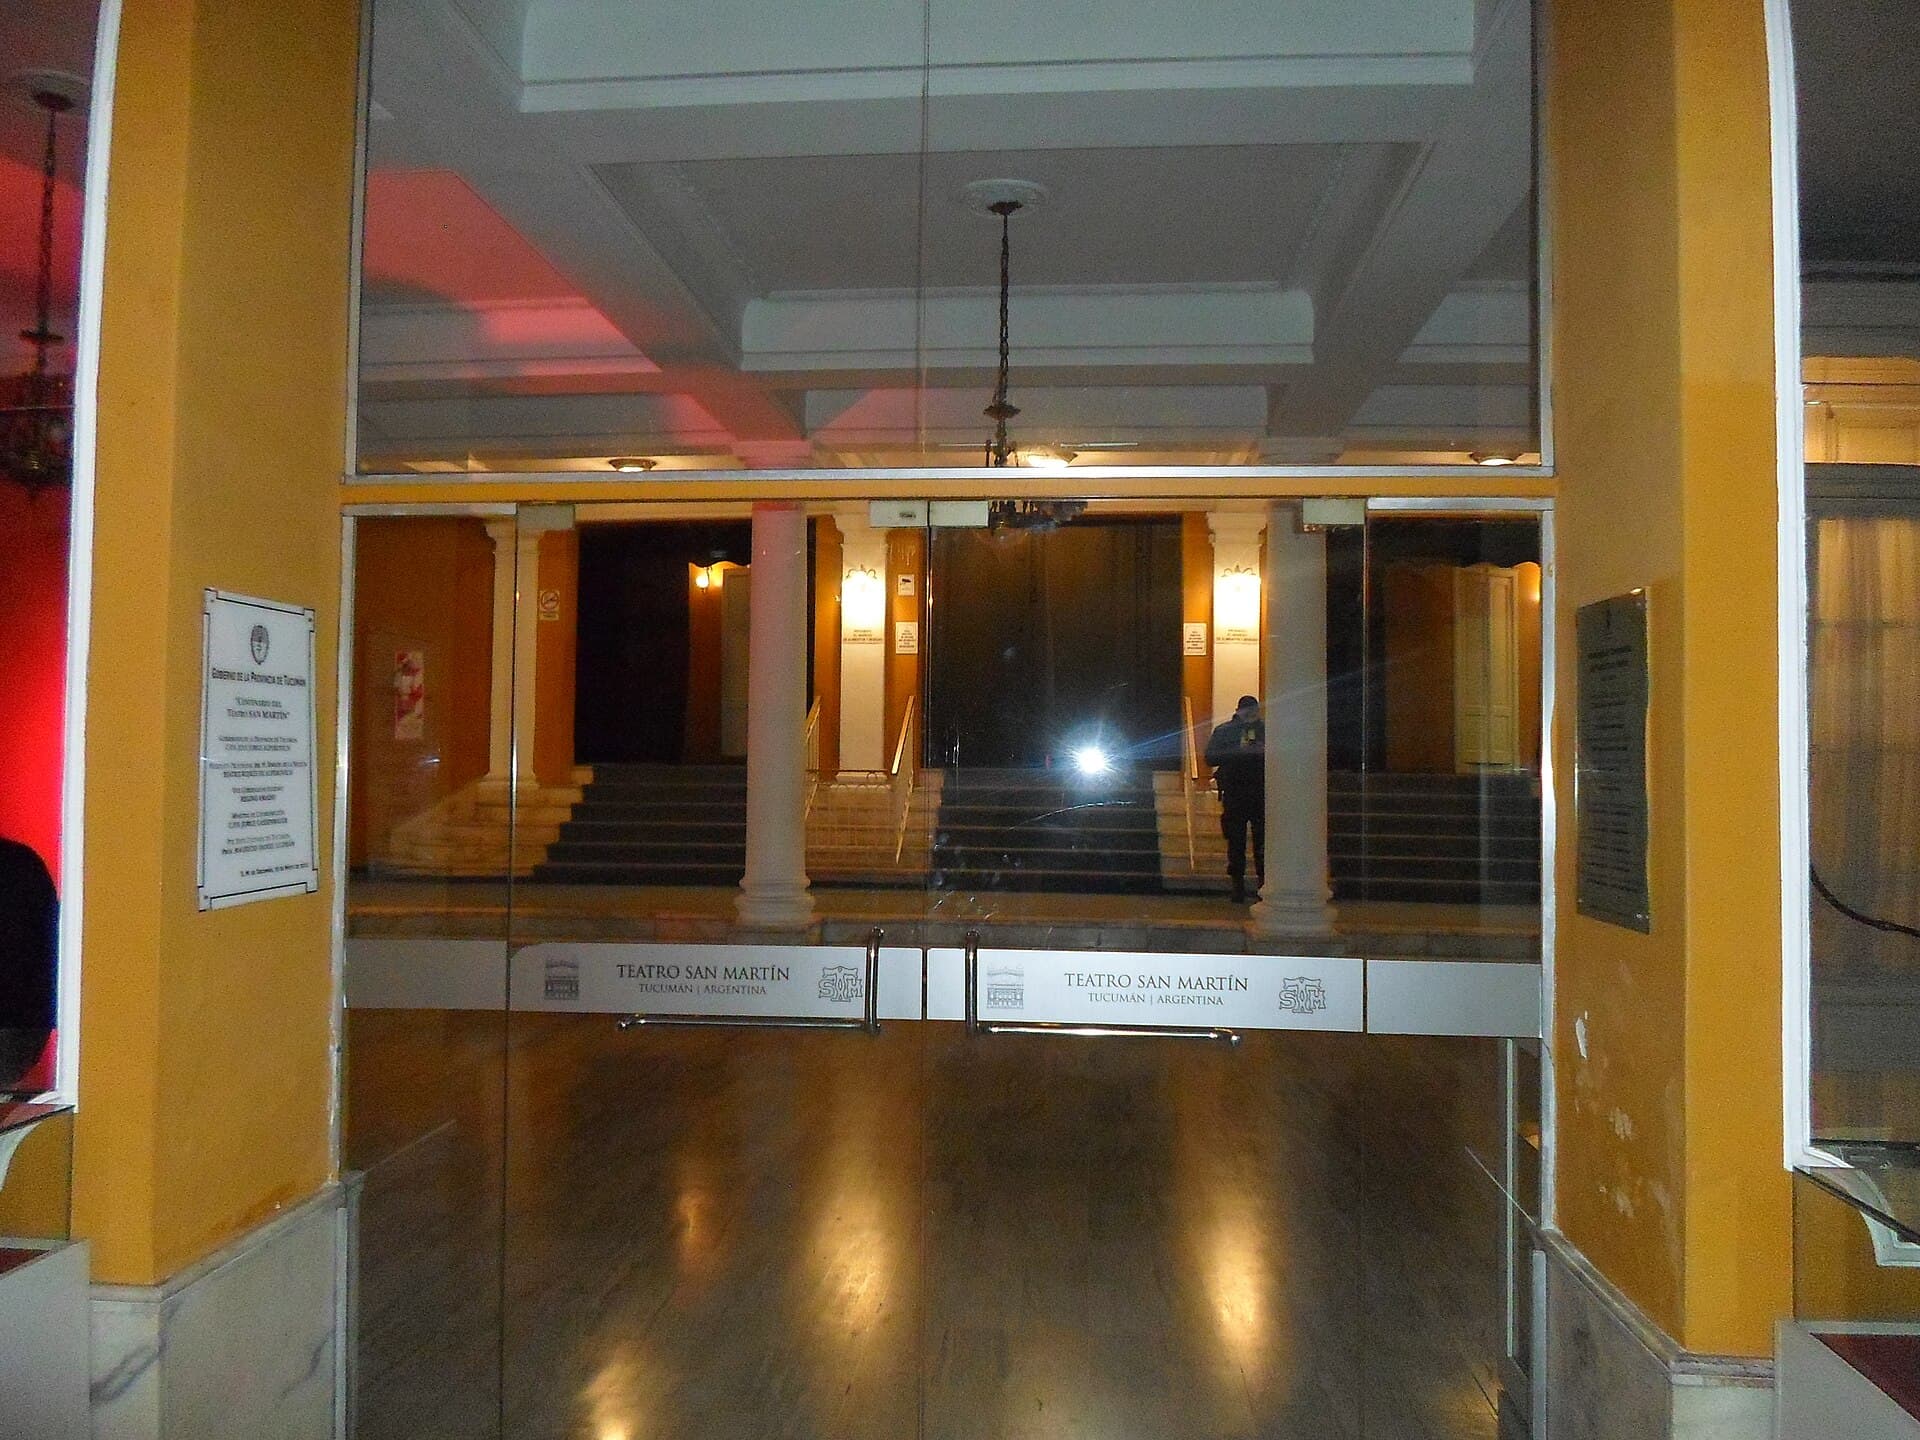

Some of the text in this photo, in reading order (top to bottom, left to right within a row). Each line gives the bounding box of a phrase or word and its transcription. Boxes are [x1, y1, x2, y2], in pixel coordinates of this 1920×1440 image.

[616, 963, 790, 981] TEATRO SAN MARTÍN
[704, 984, 767, 995] ARGENTINA
[1064, 972, 1249, 991] TEATRO SAN MARTÍN
[1088, 991, 1224, 1006] TUCUMÁN ARGENTINA
